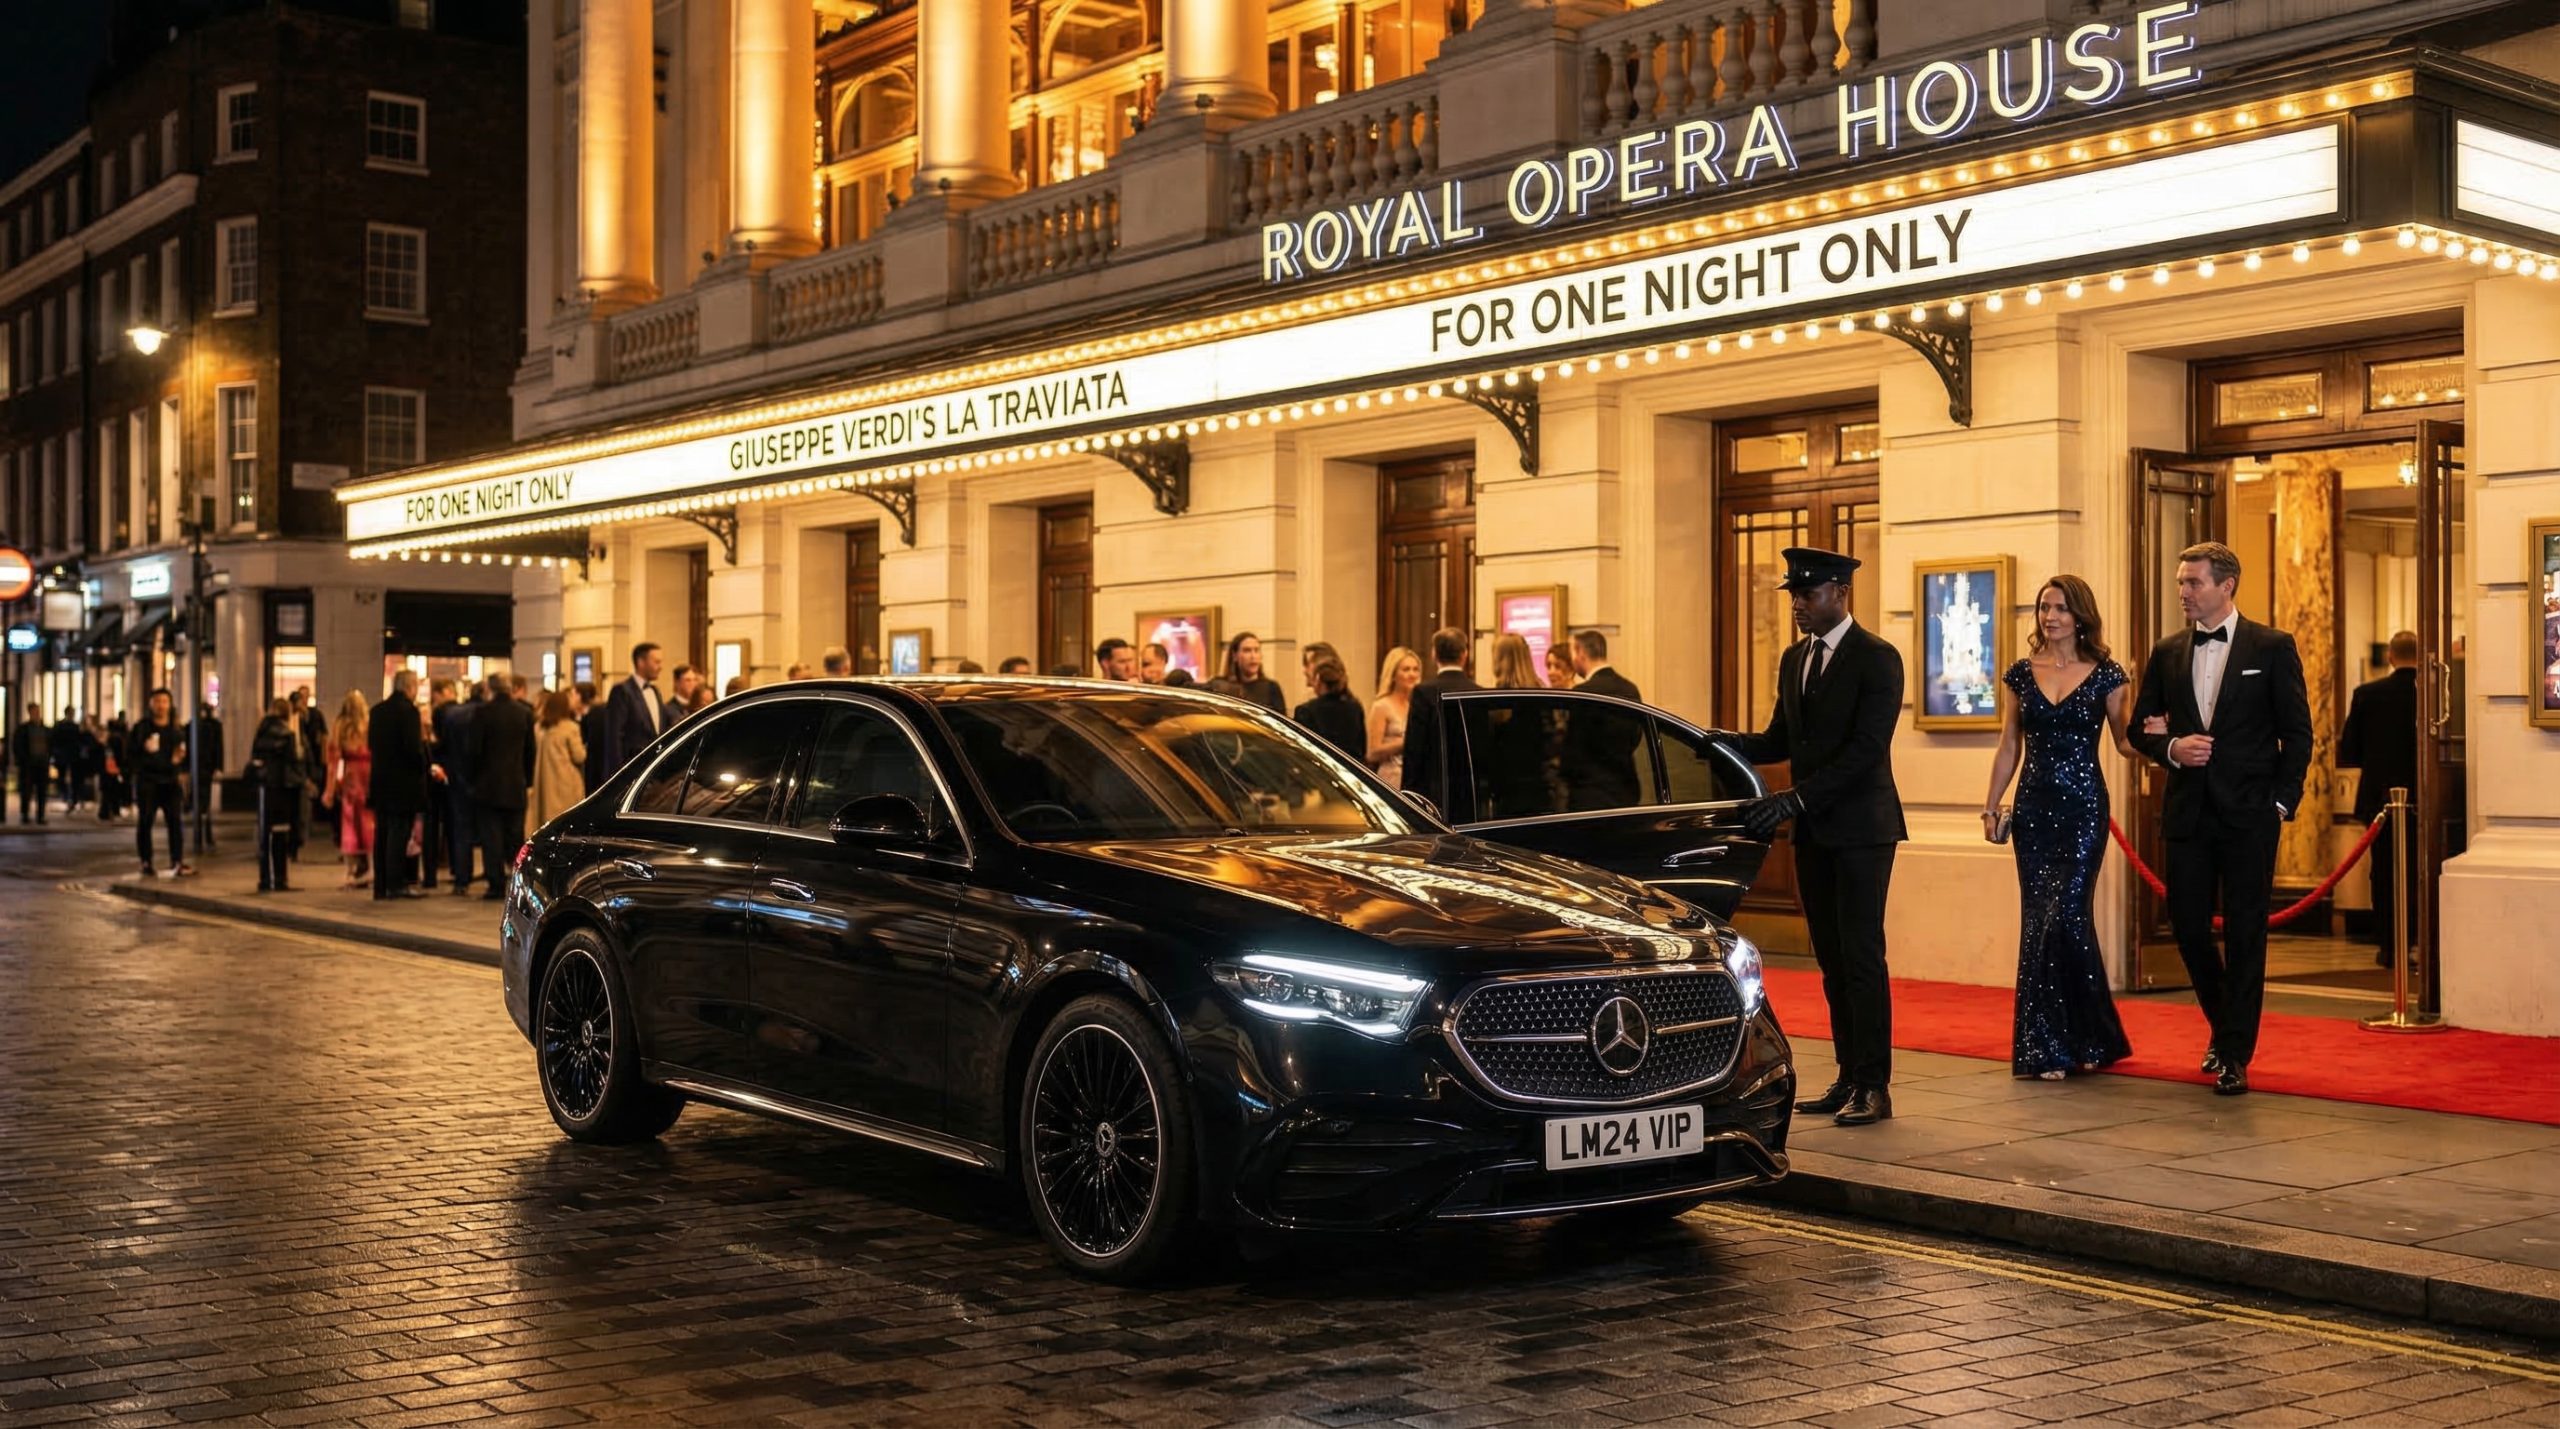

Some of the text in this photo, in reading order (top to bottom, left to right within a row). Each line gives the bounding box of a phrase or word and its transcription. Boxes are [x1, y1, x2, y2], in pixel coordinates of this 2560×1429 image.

[1262, 1, 2202, 282] ROYAL OPERA HOUSE
[1432, 208, 1973, 353] FOR ONE NIGHT ONLY
[730, 370, 1128, 471] GIUSEPPE VERDI'S LA TRAVIATA
[406, 471, 573, 523] FOR ONE NIGHT ONLY
[1561, 1112, 1692, 1161] LM24 VIP
